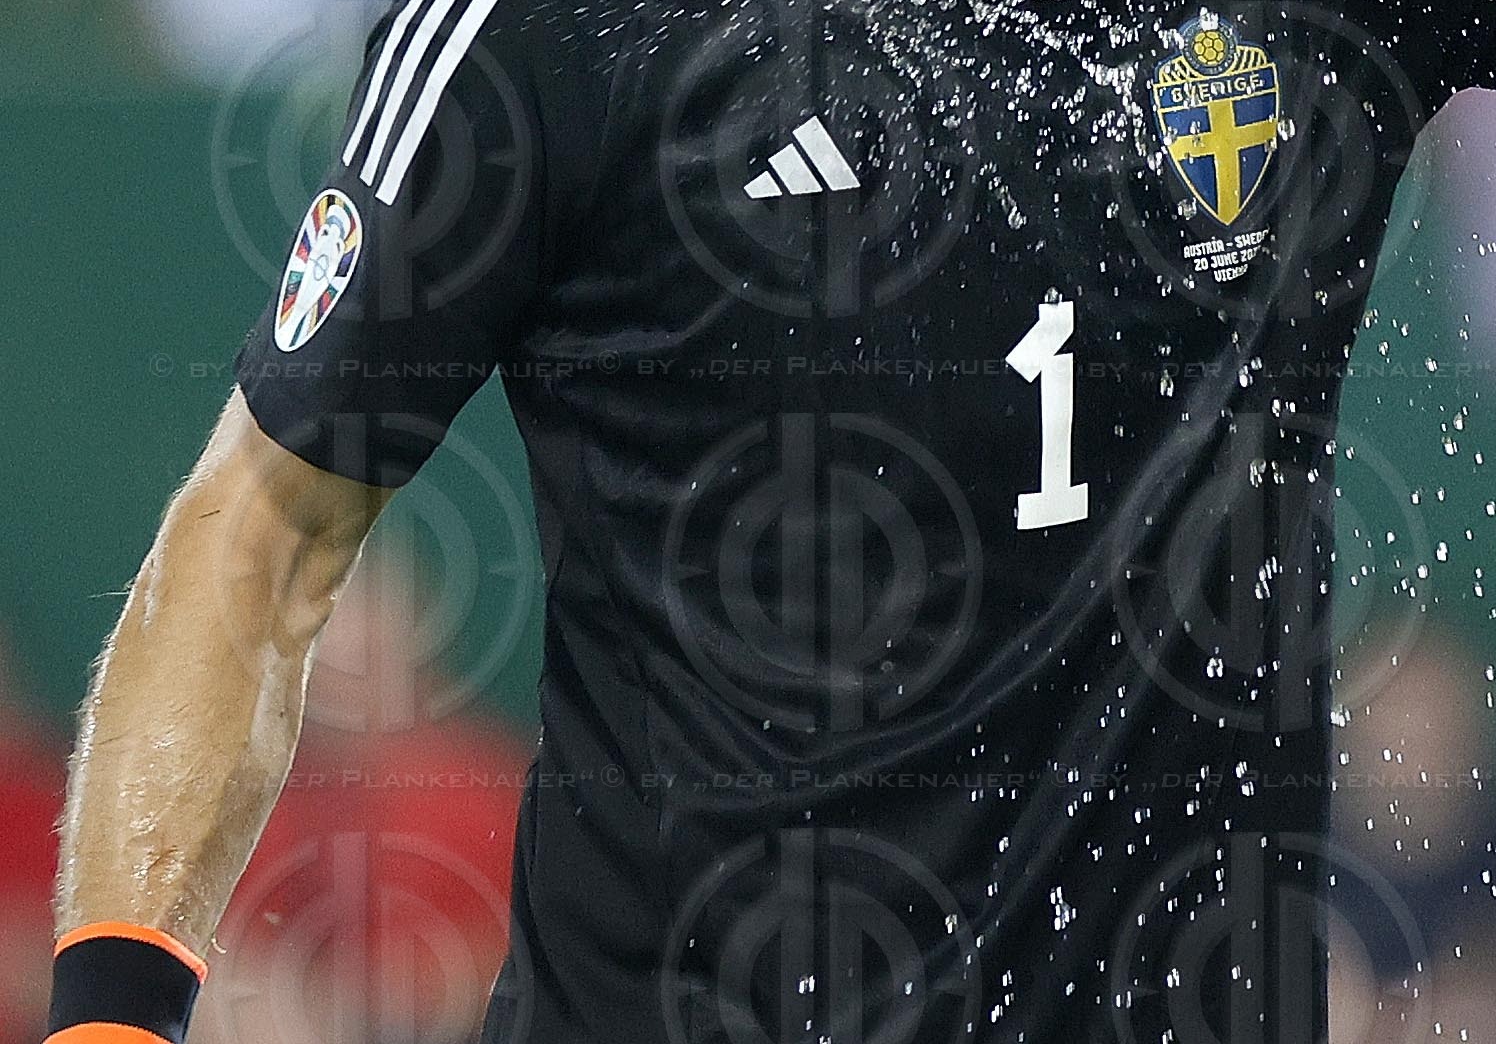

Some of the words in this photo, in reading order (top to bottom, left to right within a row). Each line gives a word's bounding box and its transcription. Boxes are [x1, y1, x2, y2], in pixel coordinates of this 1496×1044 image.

[1183, 239, 1225, 258] AUSTRIA
[1193, 257, 1209, 272] 20
[1210, 251, 1239, 269] JUNE
[1005, 300, 1089, 531] 1
